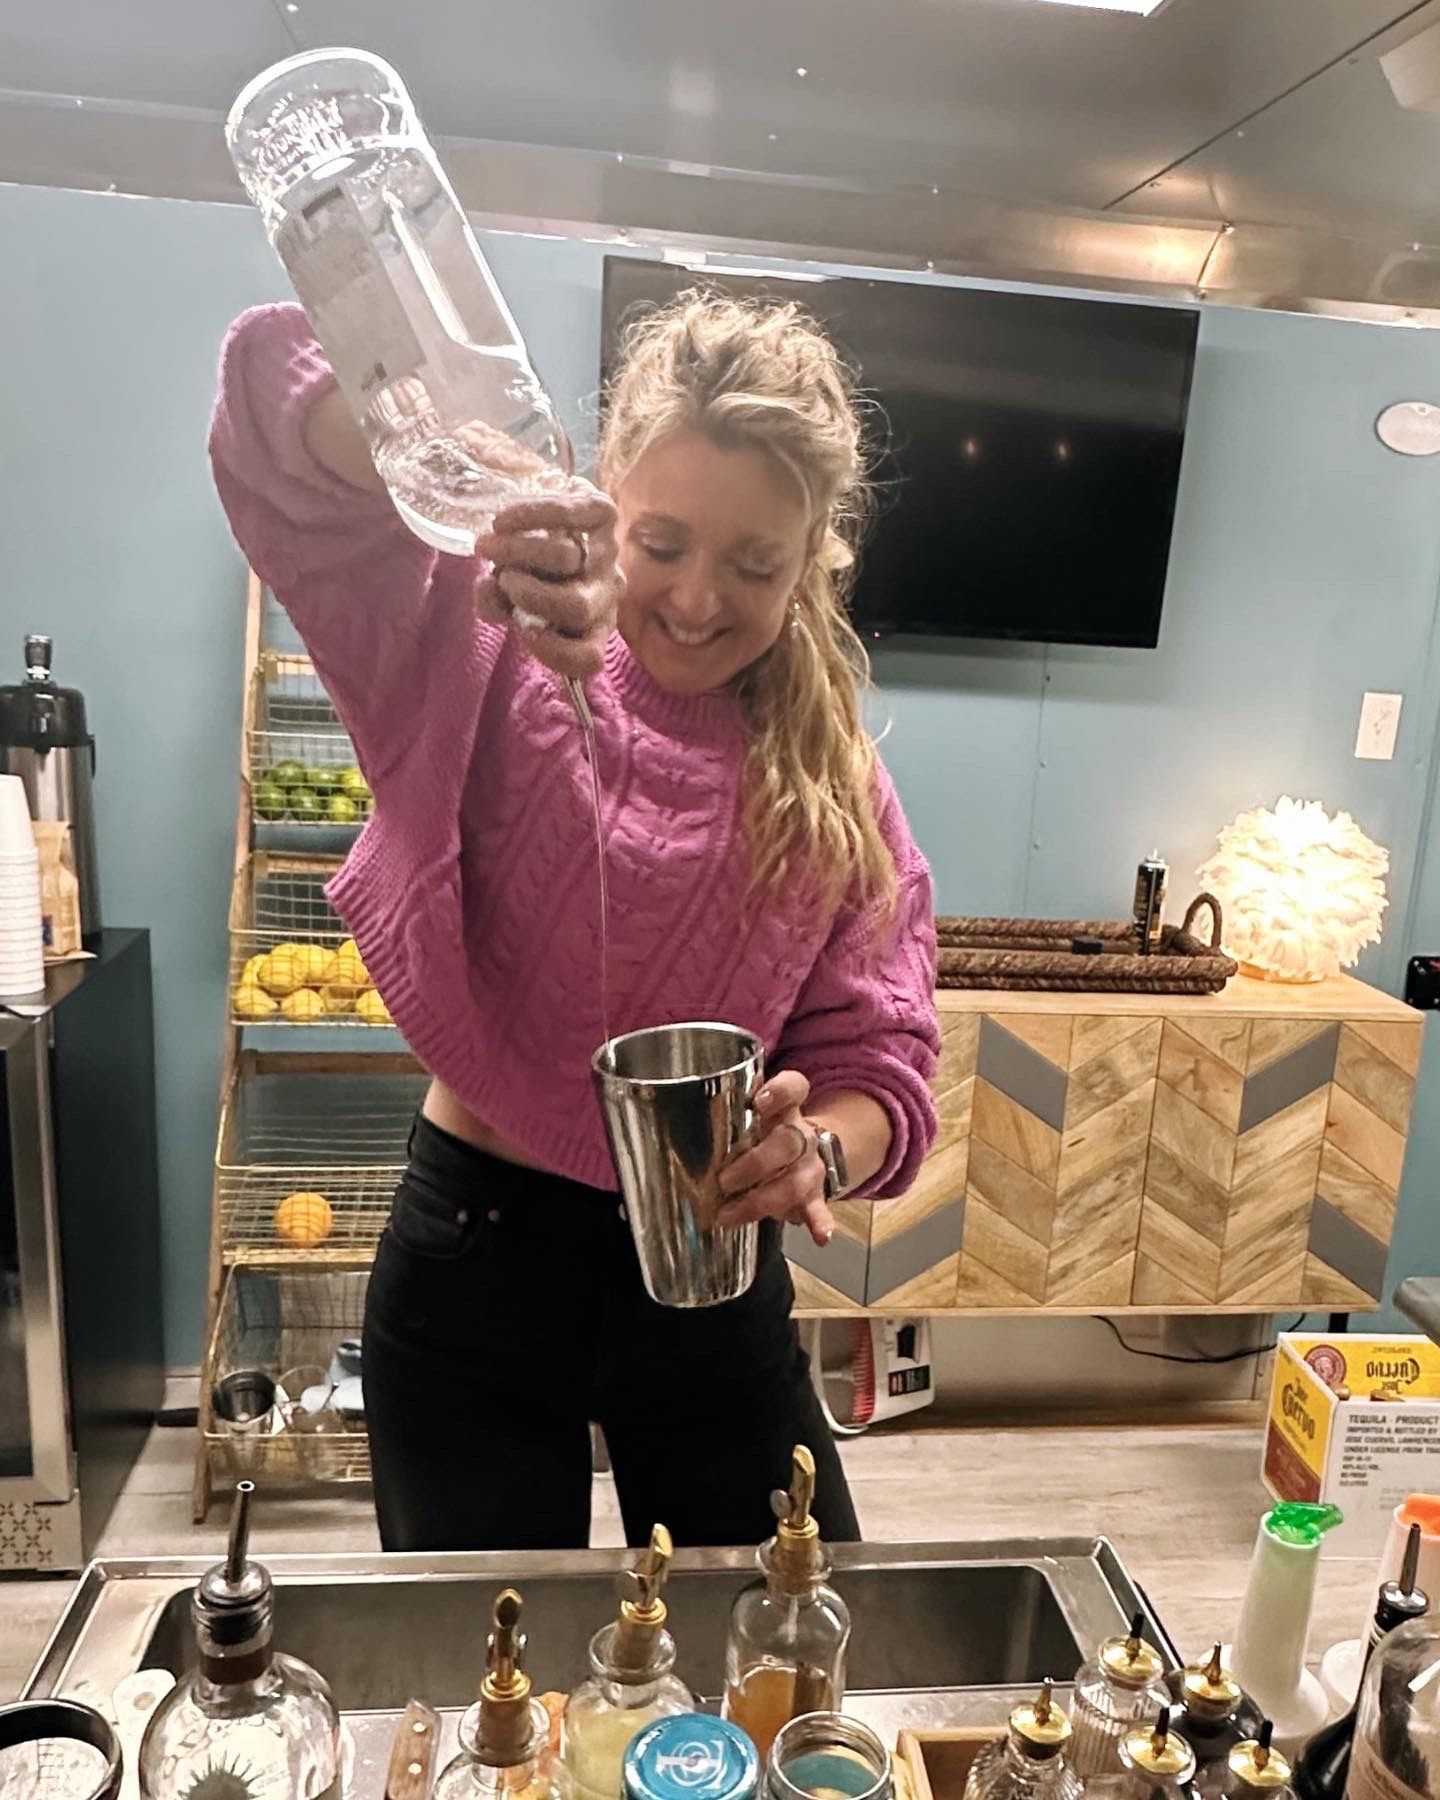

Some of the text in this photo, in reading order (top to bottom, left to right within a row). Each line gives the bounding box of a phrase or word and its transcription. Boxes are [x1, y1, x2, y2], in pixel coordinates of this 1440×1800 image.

[1366, 1358, 1420, 1385] Cuervo
[1282, 1383, 1316, 1440] Cuervo
[1348, 1414, 1439, 1425] TEQUILA PRODUCT
